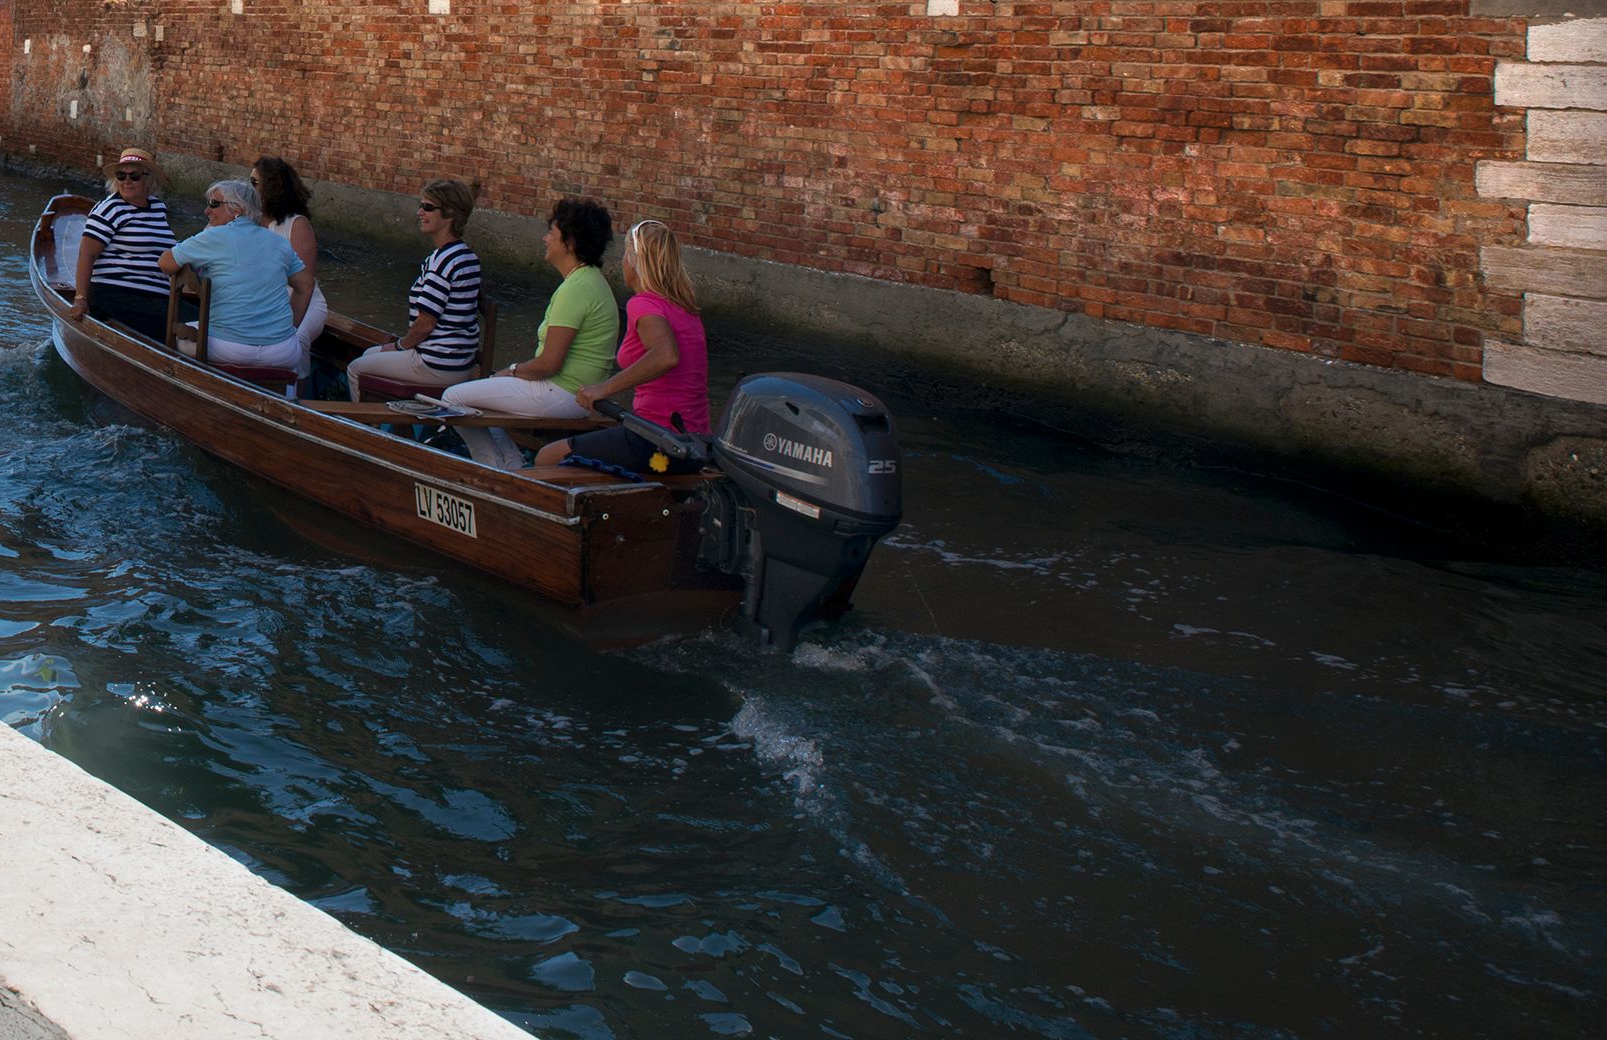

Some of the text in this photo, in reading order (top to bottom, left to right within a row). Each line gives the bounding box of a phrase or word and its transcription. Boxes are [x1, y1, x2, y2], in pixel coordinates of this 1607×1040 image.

[778, 437, 833, 468] YAMAHA
[868, 460, 896, 474] 25
[416, 485, 472, 534] LV 53057
